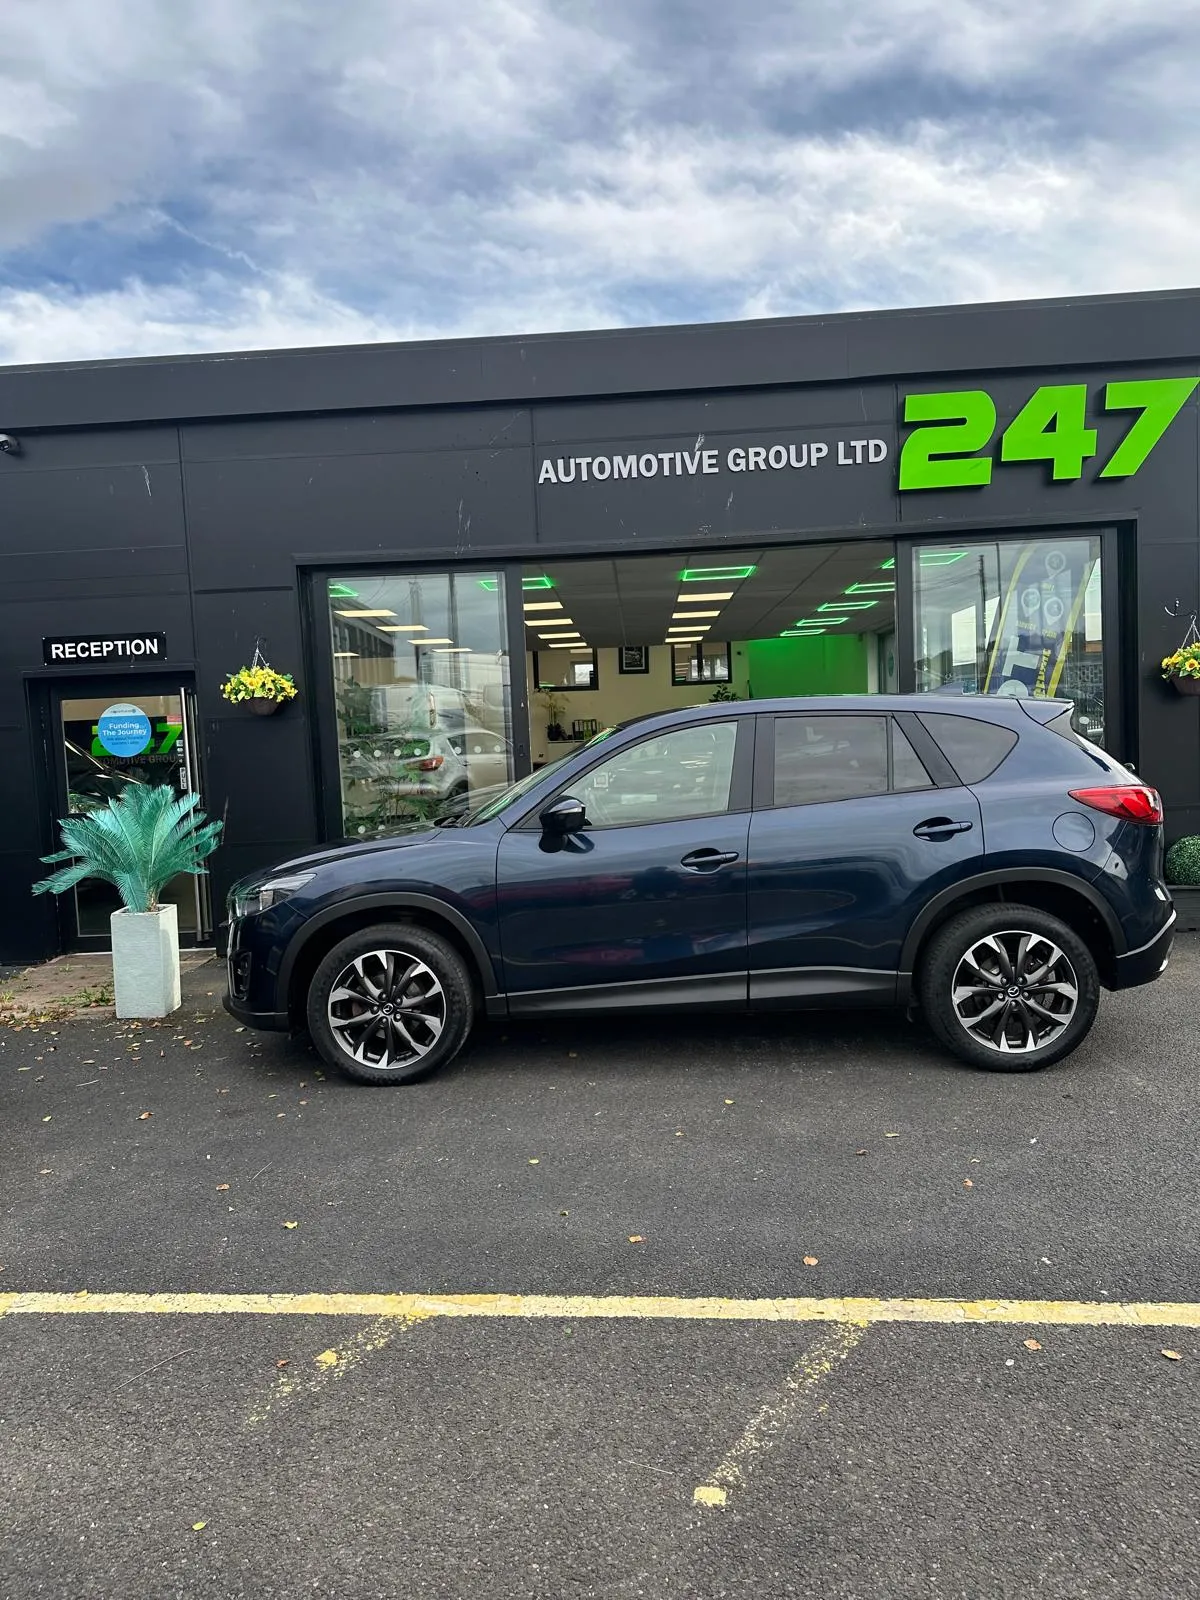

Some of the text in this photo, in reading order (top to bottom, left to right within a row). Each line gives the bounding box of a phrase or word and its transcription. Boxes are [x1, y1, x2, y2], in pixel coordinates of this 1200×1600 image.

[898, 377, 1200, 490] 247
[538, 439, 888, 484] AUTOMOTIVE GROUP LTD
[50, 638, 159, 660] RECEPTION
[102, 728, 147, 737] The Journey
[108, 722, 140, 730] Funding
